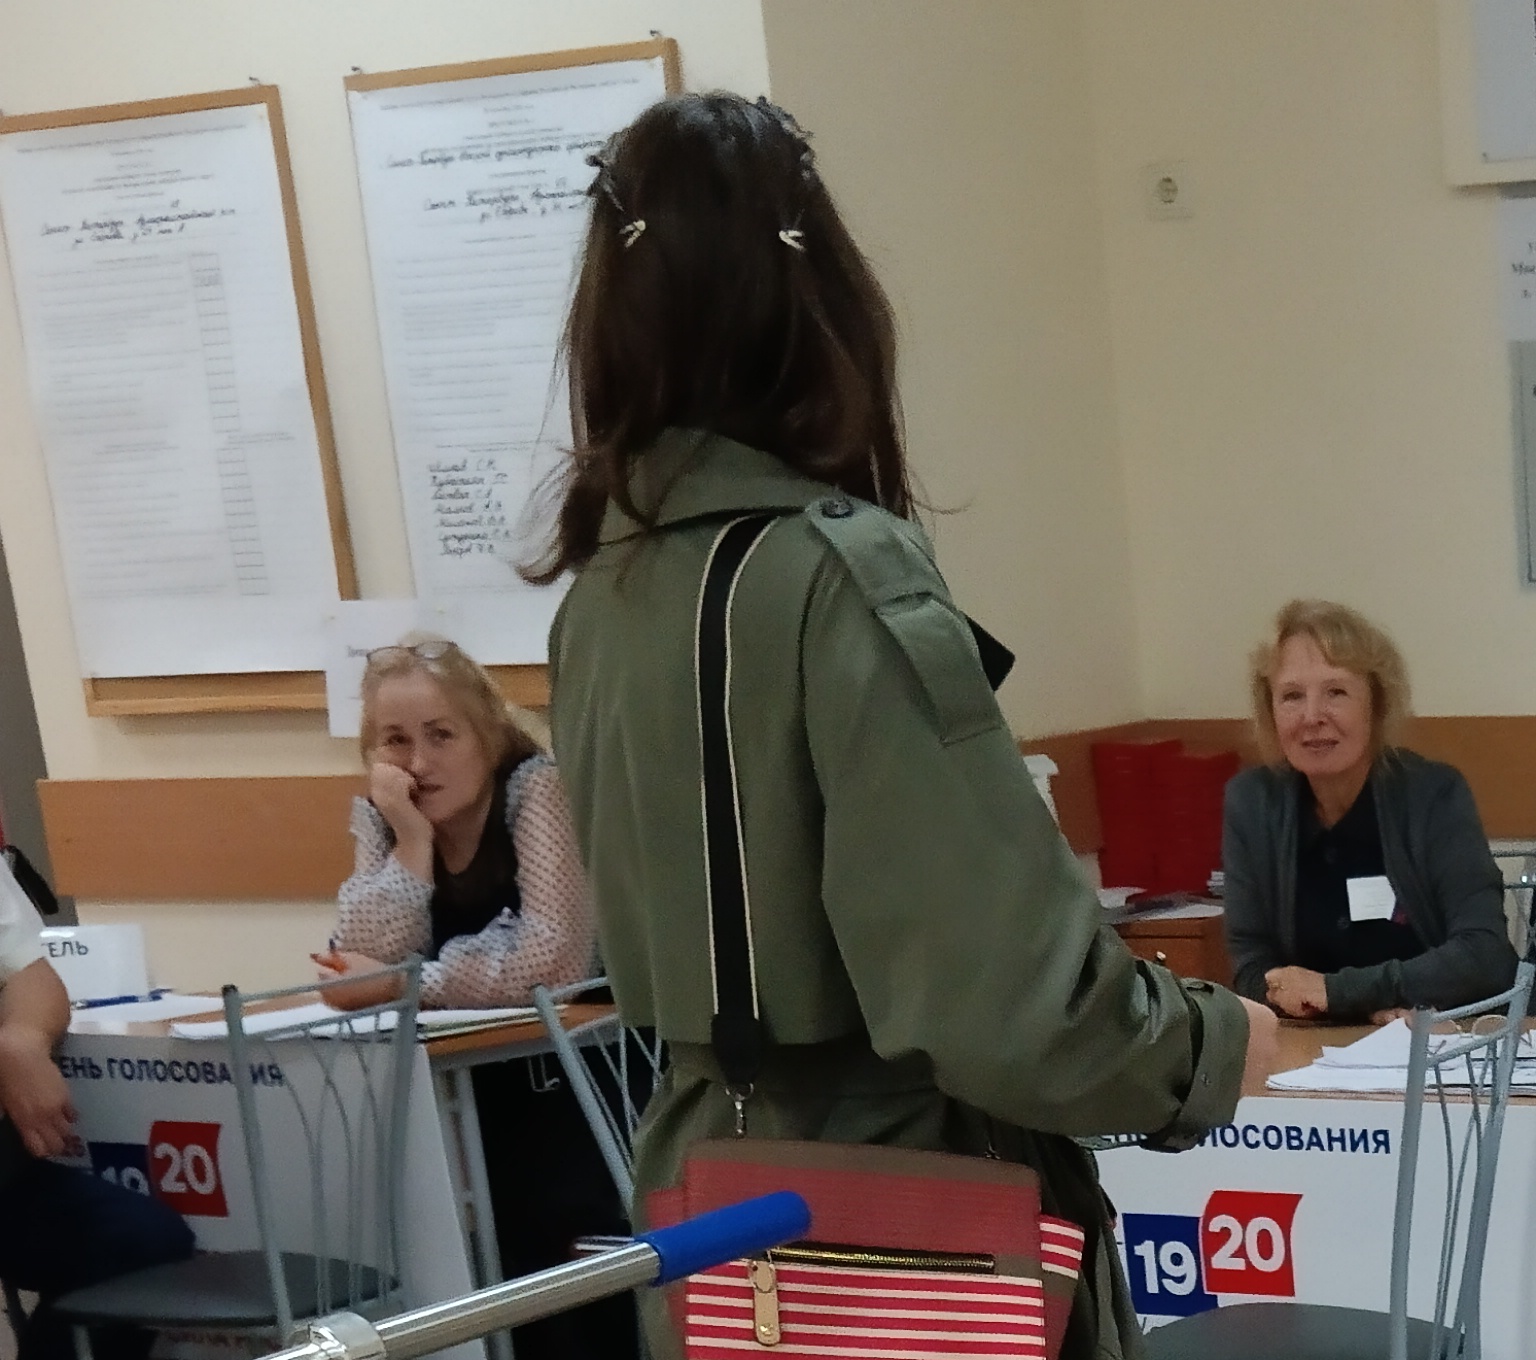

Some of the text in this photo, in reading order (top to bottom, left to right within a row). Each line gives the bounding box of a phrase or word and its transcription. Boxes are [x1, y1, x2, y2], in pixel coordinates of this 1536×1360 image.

[60, 1056, 284, 1087] ЕНЬ ГОЛОСОВАИЯ
[1198, 1123, 1392, 1155] ЛОСОВАНИЯ
[153, 1142, 216, 1195] 20
[1133, 1239, 1198, 1296] 19
[1208, 1214, 1286, 1273] 20
